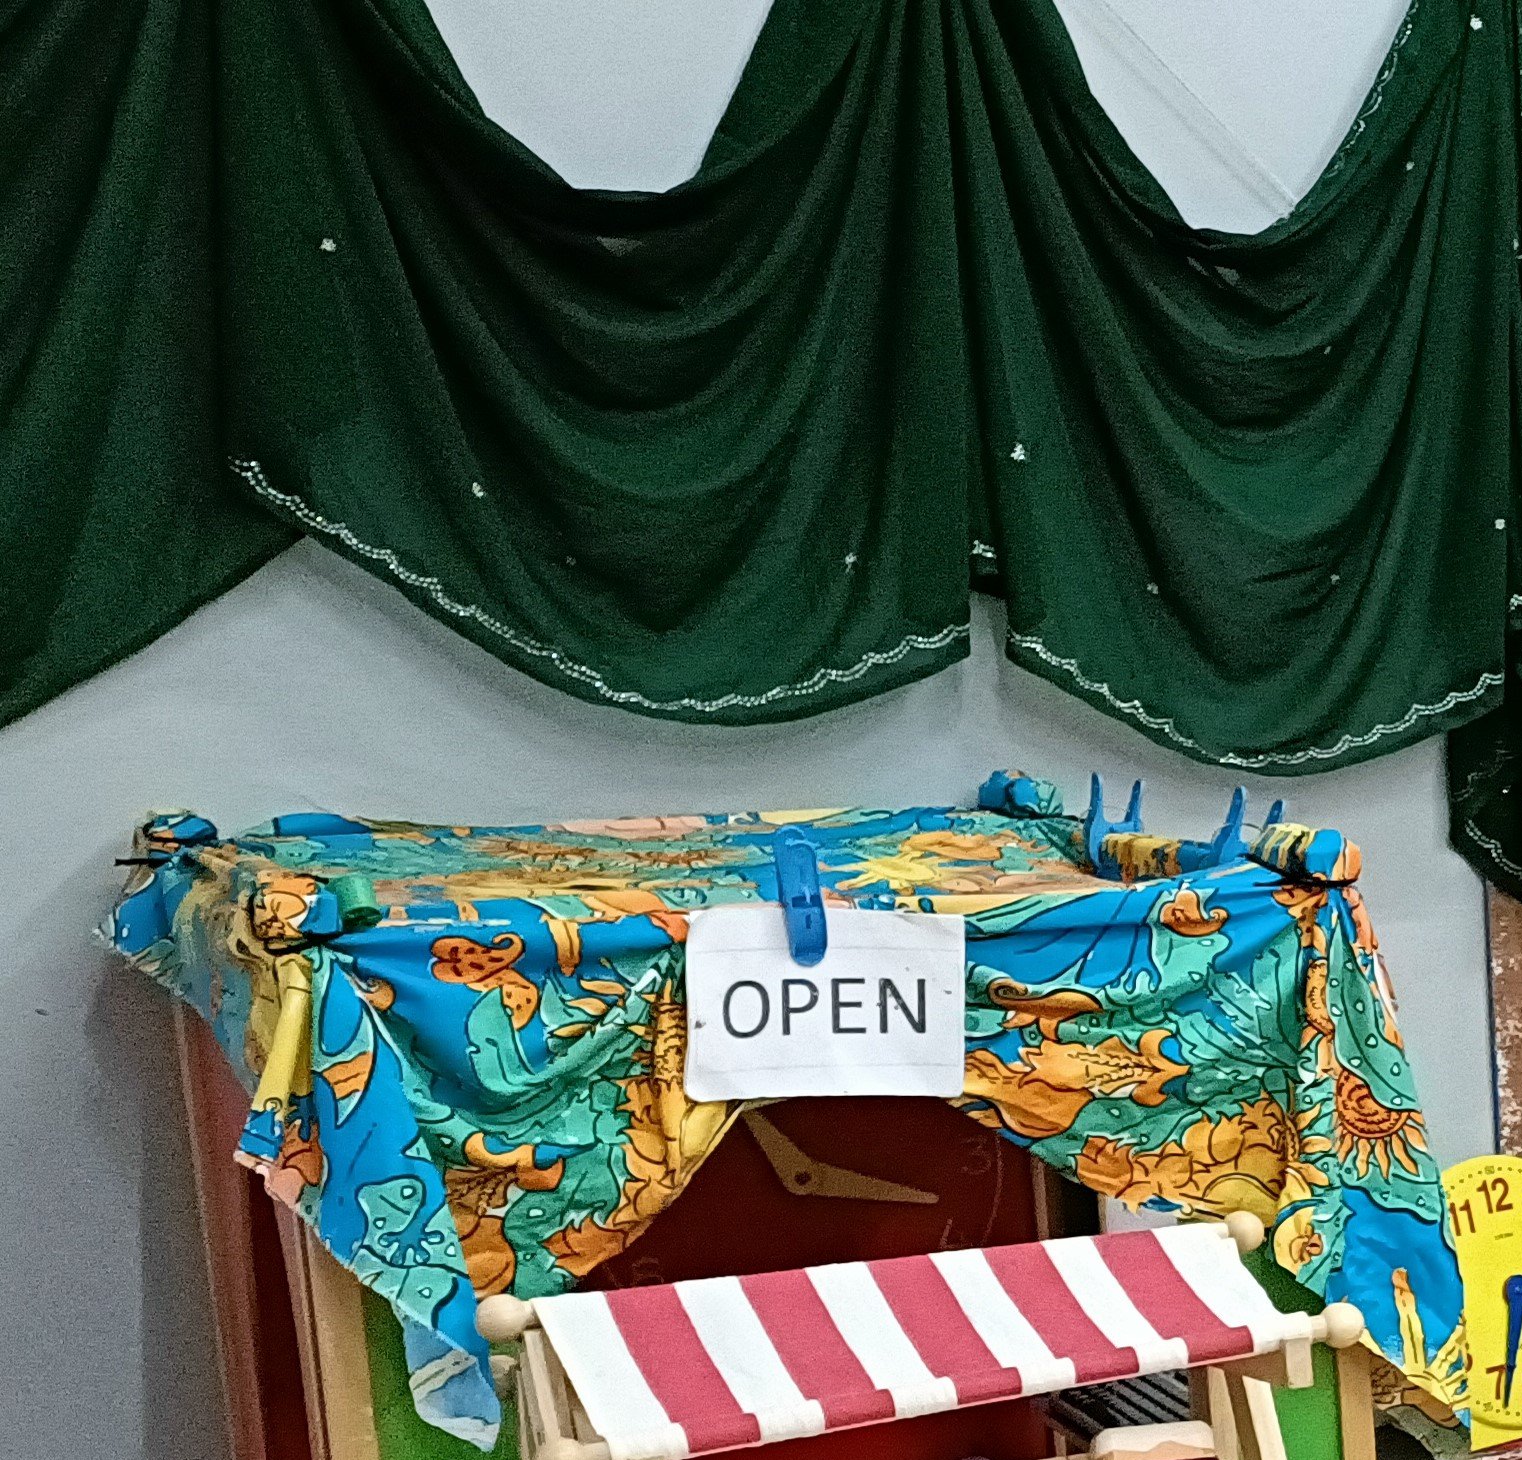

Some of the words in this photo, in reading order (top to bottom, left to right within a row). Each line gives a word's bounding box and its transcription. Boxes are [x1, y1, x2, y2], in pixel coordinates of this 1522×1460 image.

[723, 978, 926, 1039] OPEN
[1476, 1177, 1513, 1214] 12
[1449, 1199, 1476, 1237] 11
[1486, 1364, 1506, 1400] 7
